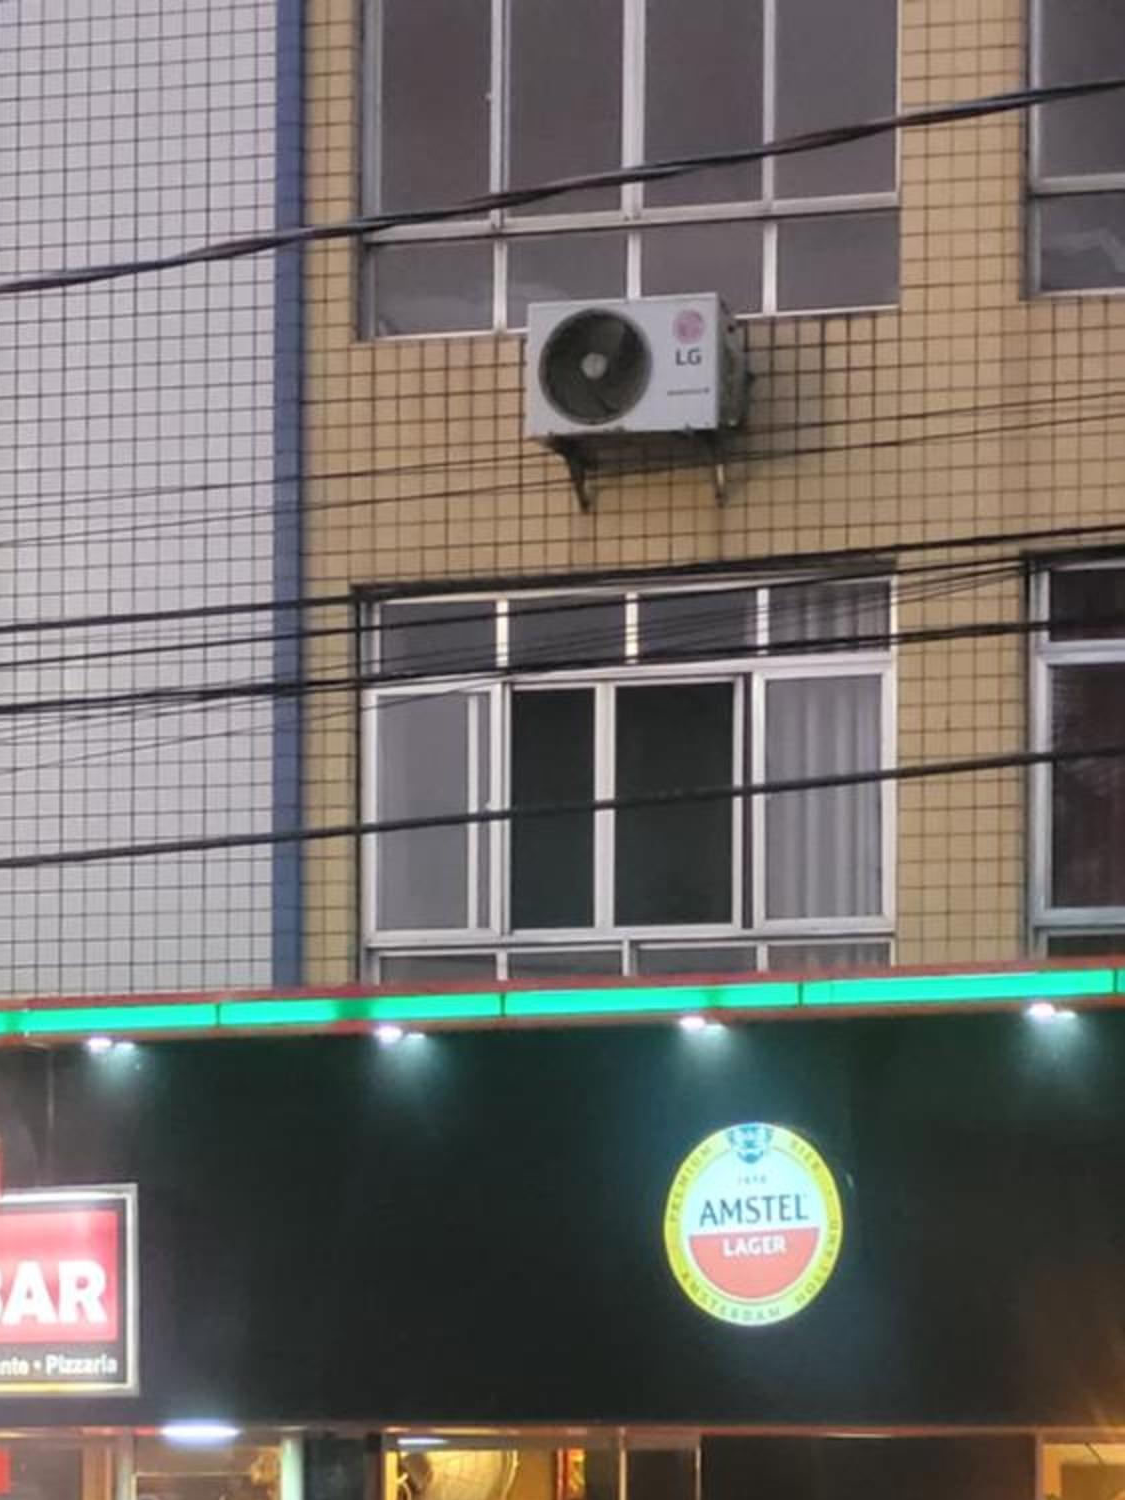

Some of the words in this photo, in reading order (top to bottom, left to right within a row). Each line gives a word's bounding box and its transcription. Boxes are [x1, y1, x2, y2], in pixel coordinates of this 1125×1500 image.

[676, 348, 702, 366] LG
[699, 1193, 809, 1228] AMSTEL
[723, 1235, 786, 1257] LAGER
[45, 1352, 118, 1375] Pizzaria
